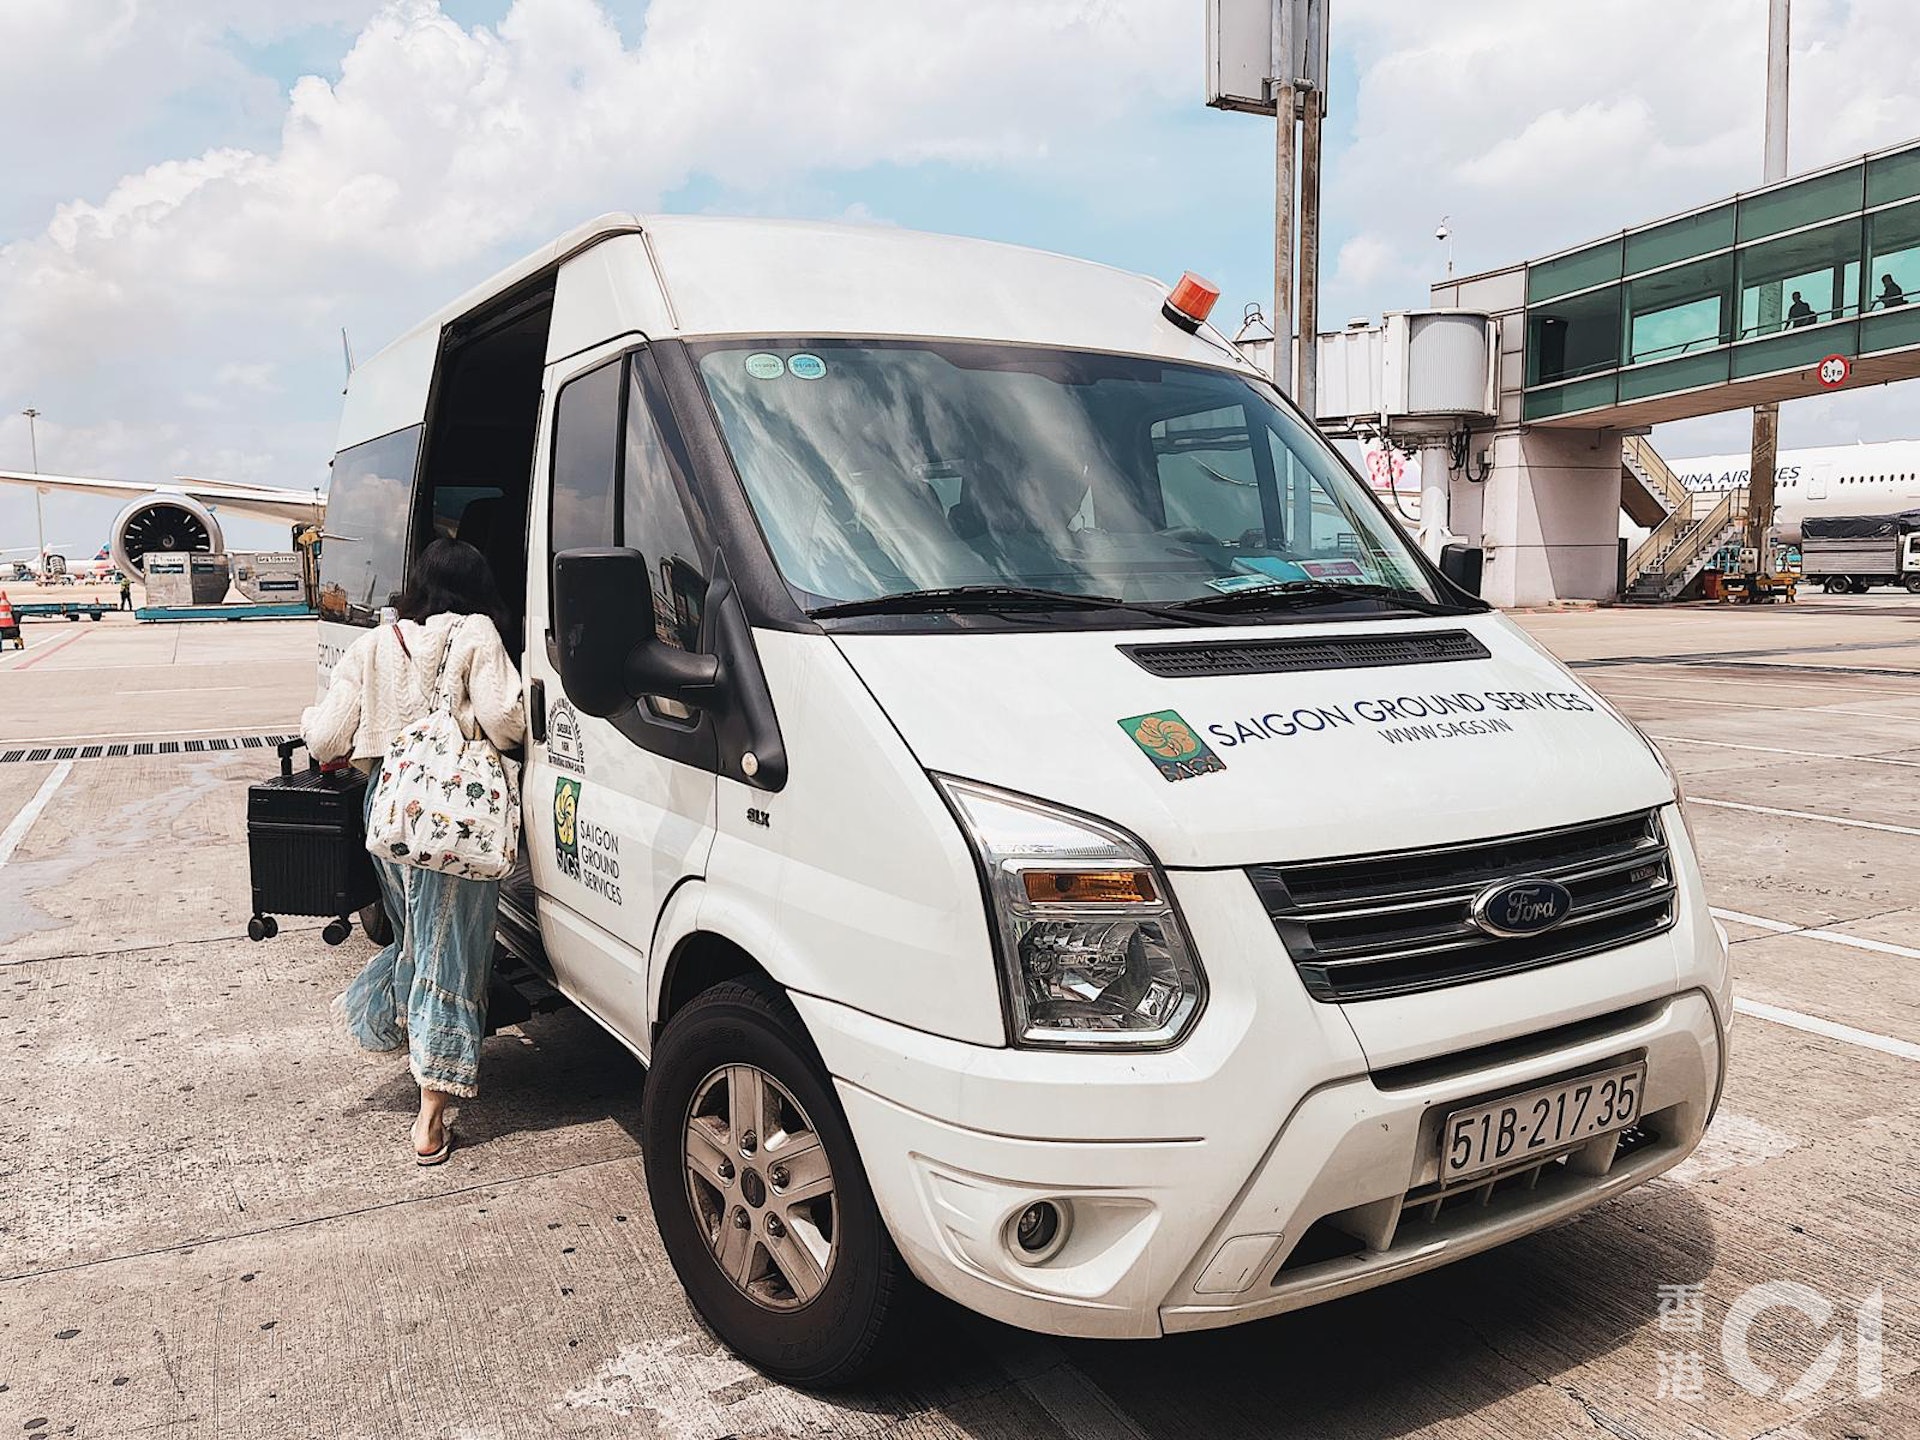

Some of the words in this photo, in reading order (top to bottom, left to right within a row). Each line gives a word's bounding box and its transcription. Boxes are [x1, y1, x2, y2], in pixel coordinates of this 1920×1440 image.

[1679, 473, 1713, 486] INA
[1717, 466, 1802, 483] AIRES
[1208, 705, 1355, 746] SAIGON
[1354, 693, 1484, 722] GROUND
[1484, 692, 1594, 712] SERVICES
[1377, 718, 1513, 744] WWW.SAGS.VN
[747, 808, 770, 828] SLX
[580, 820, 618, 855] SAIGON
[556, 847, 582, 882] SAGS
[581, 845, 619, 879] GROUND
[583, 869, 622, 905] SERVICES
[1506, 888, 1557, 925] Ford
[1450, 1073, 1637, 1170] 51B-217.35
